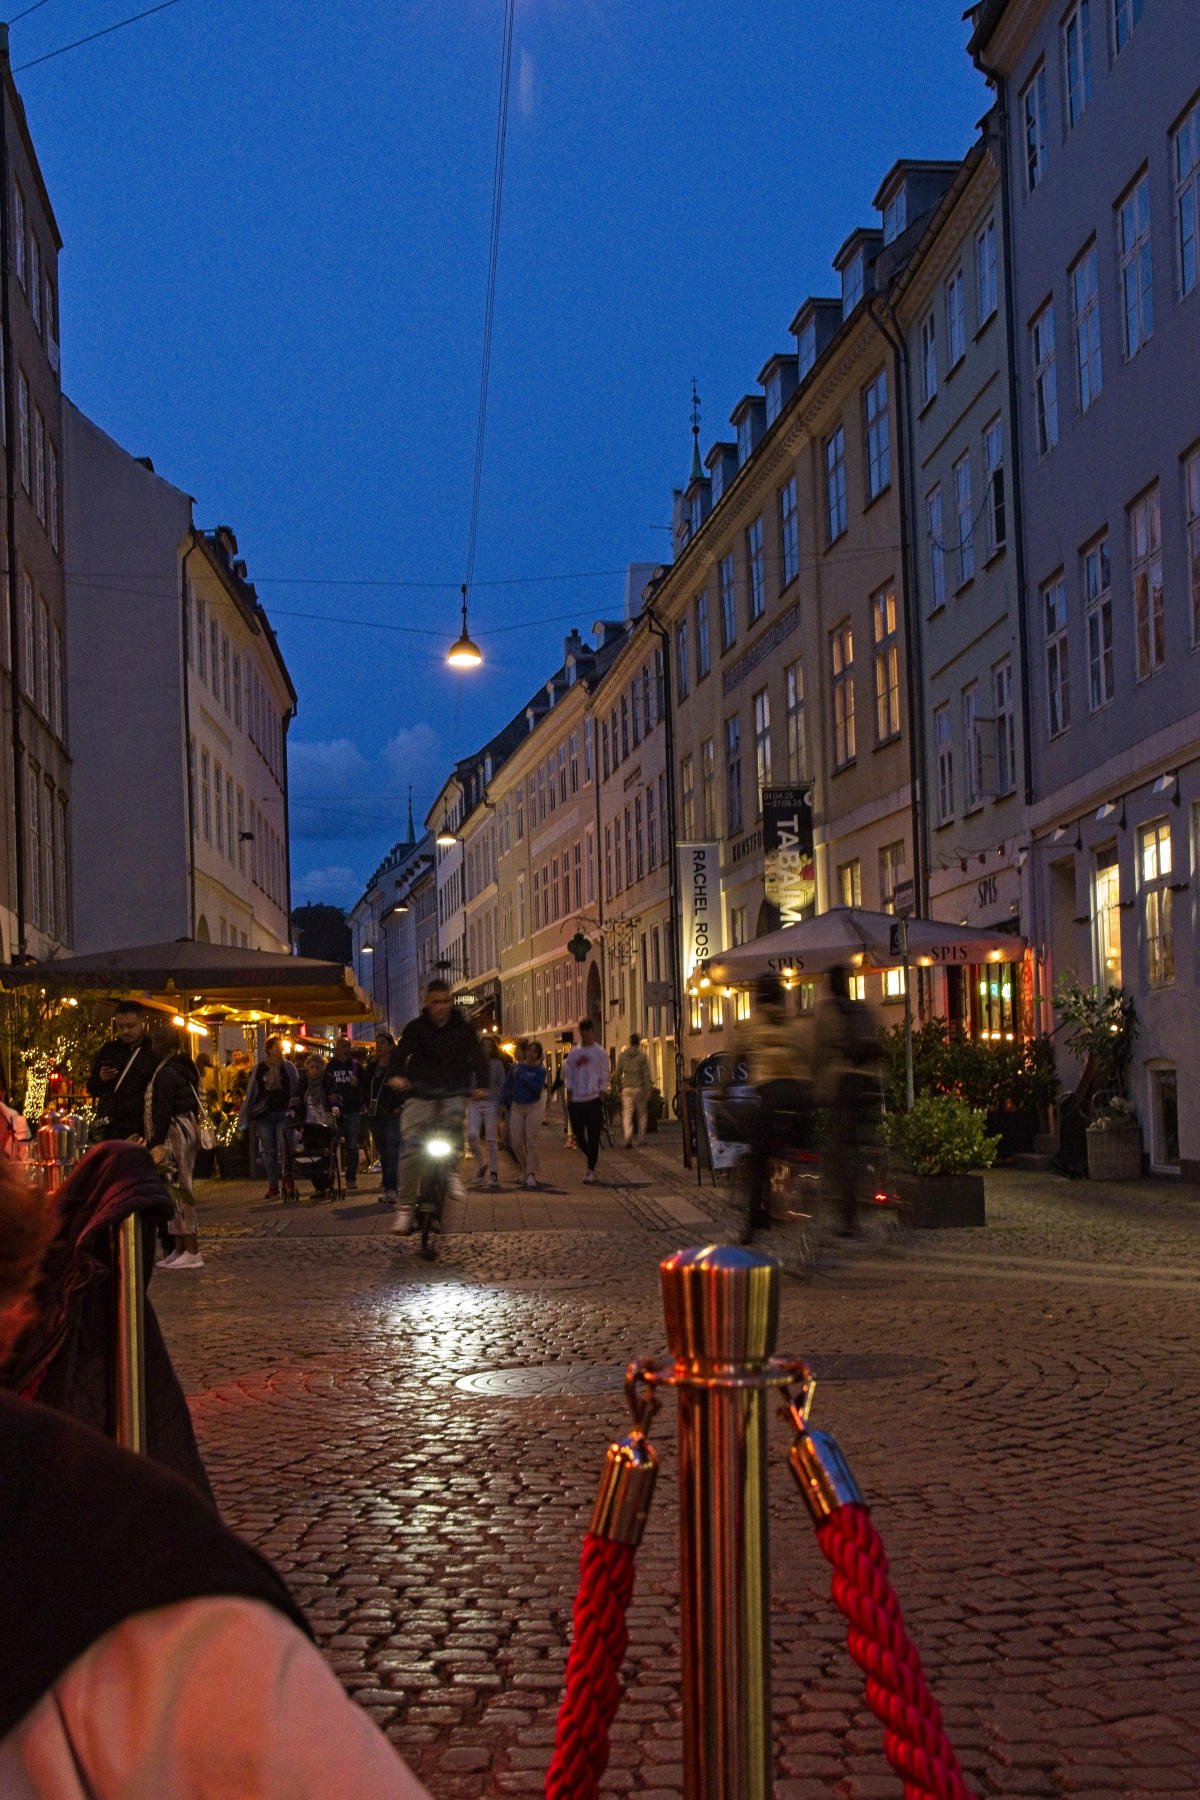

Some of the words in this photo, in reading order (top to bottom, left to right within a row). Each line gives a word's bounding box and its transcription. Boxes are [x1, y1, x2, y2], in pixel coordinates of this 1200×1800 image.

[693, 849, 707, 916] RACHEL
[777, 814, 802, 929] TABAIM
[978, 876, 997, 908] SPIS
[767, 956, 804, 971] SPIS
[931, 945, 968, 960] SPIS
[704, 1062, 749, 1084] SPIS
